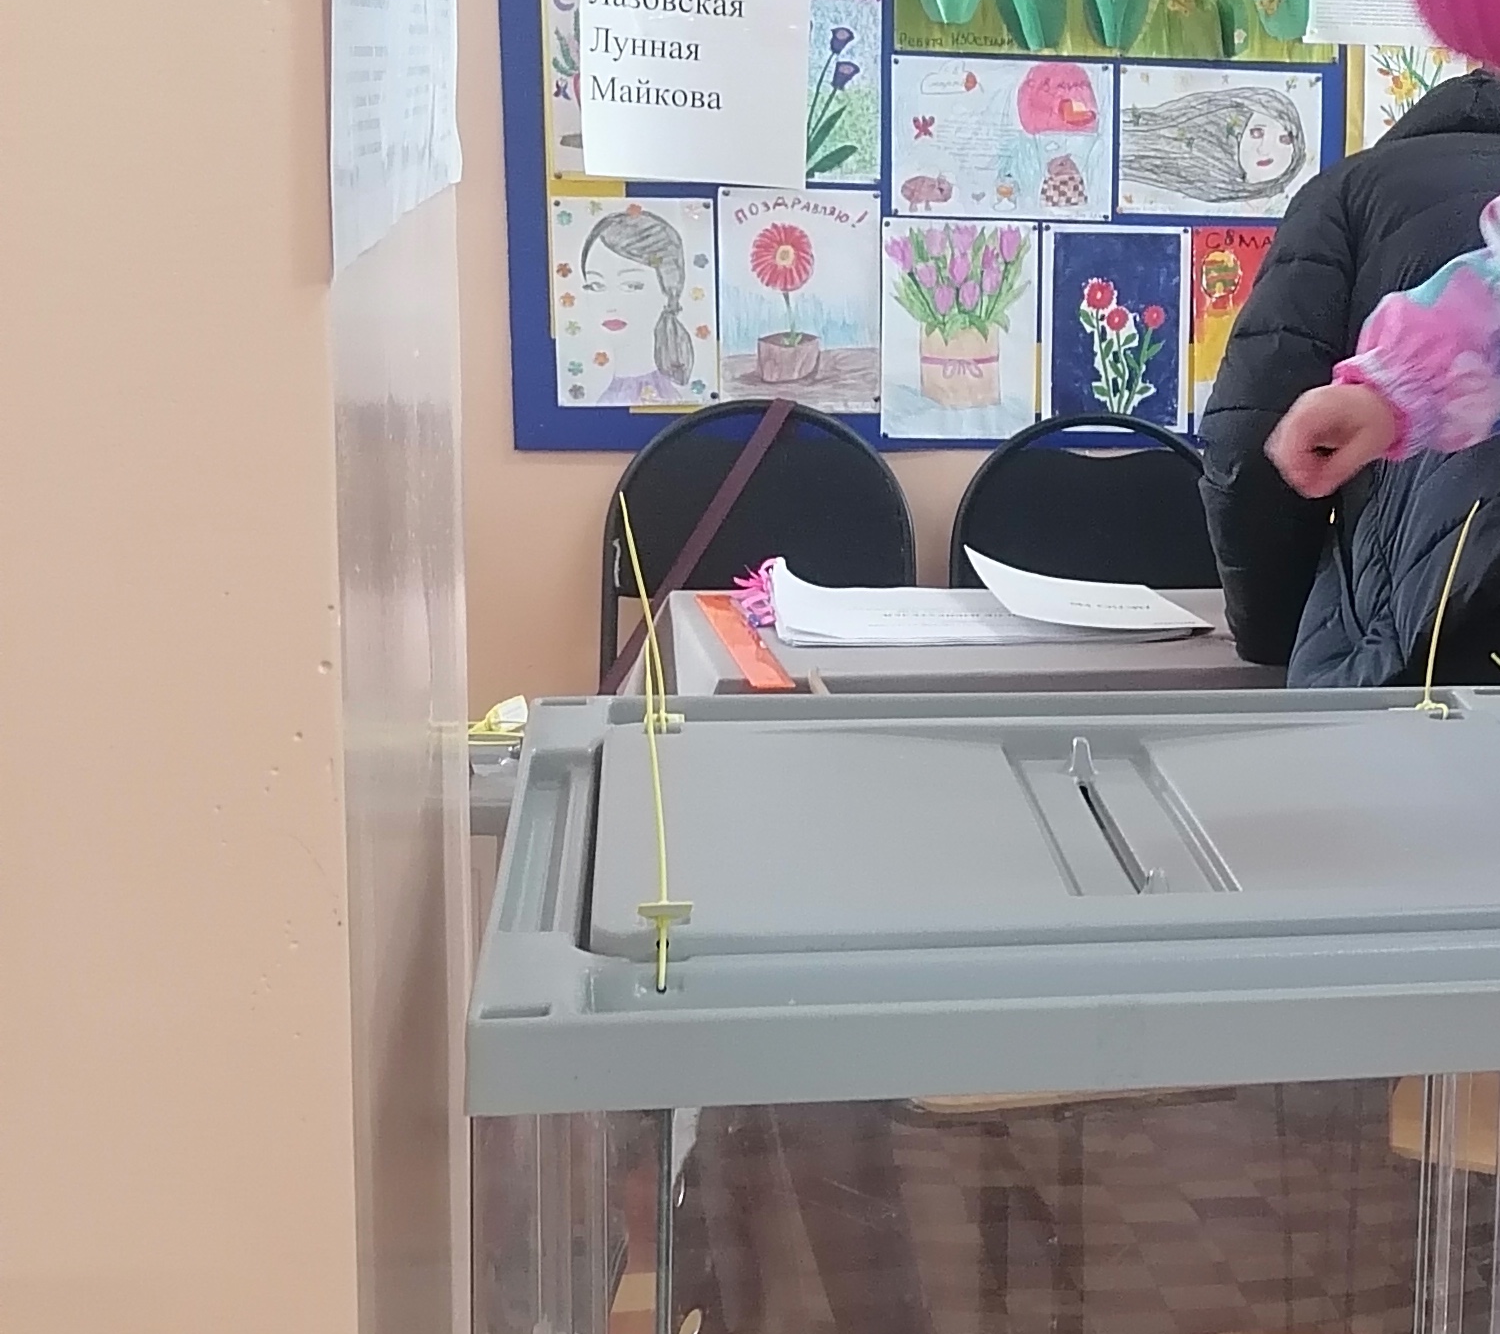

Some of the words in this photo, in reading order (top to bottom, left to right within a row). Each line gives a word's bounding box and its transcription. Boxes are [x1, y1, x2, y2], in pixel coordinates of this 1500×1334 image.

[590, 29, 701, 66] Лунная
[590, 76, 723, 111] Майкова
[1238, 230, 1274, 250] МА
